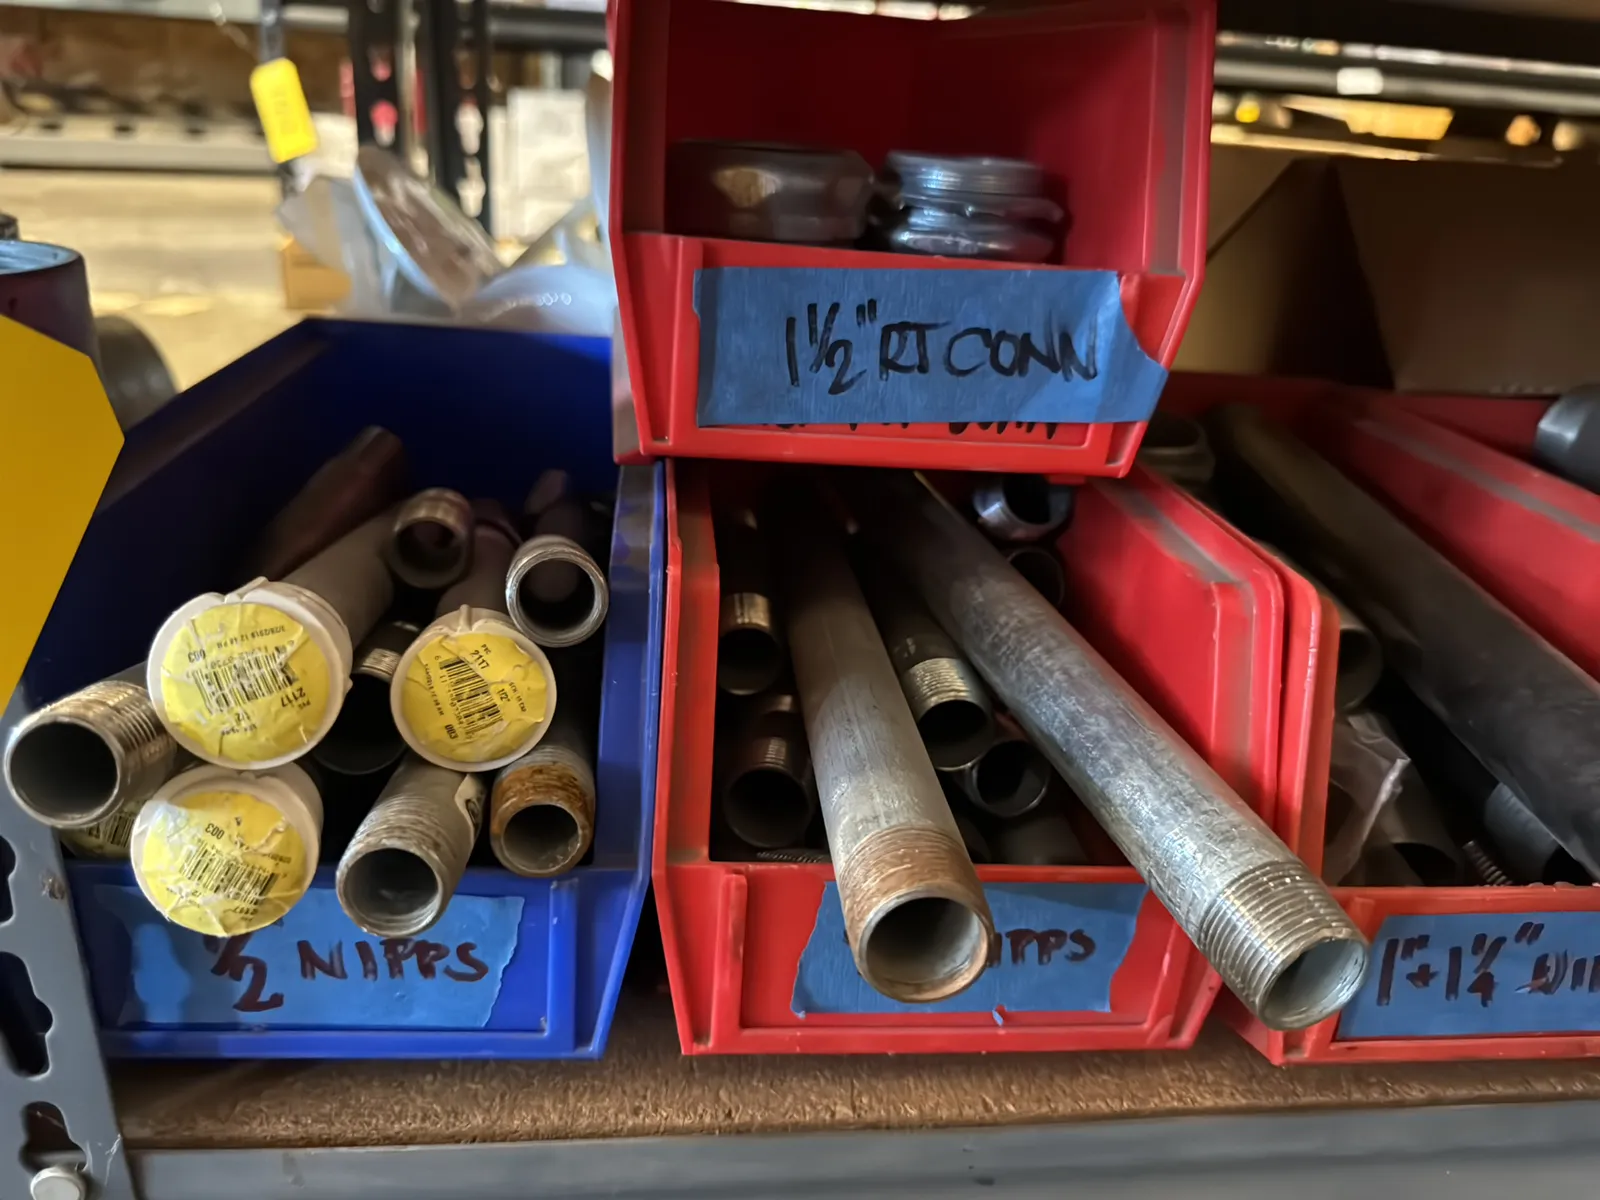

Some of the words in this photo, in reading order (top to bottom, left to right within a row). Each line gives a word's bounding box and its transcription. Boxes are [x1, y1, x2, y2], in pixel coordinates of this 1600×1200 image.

[944, 324, 1099, 382] CONN
[470, 649, 491, 670] 2117
[281, 687, 307, 708] 2117
[205, 822, 225, 840] 003
[297, 936, 489, 982] NIPPS
